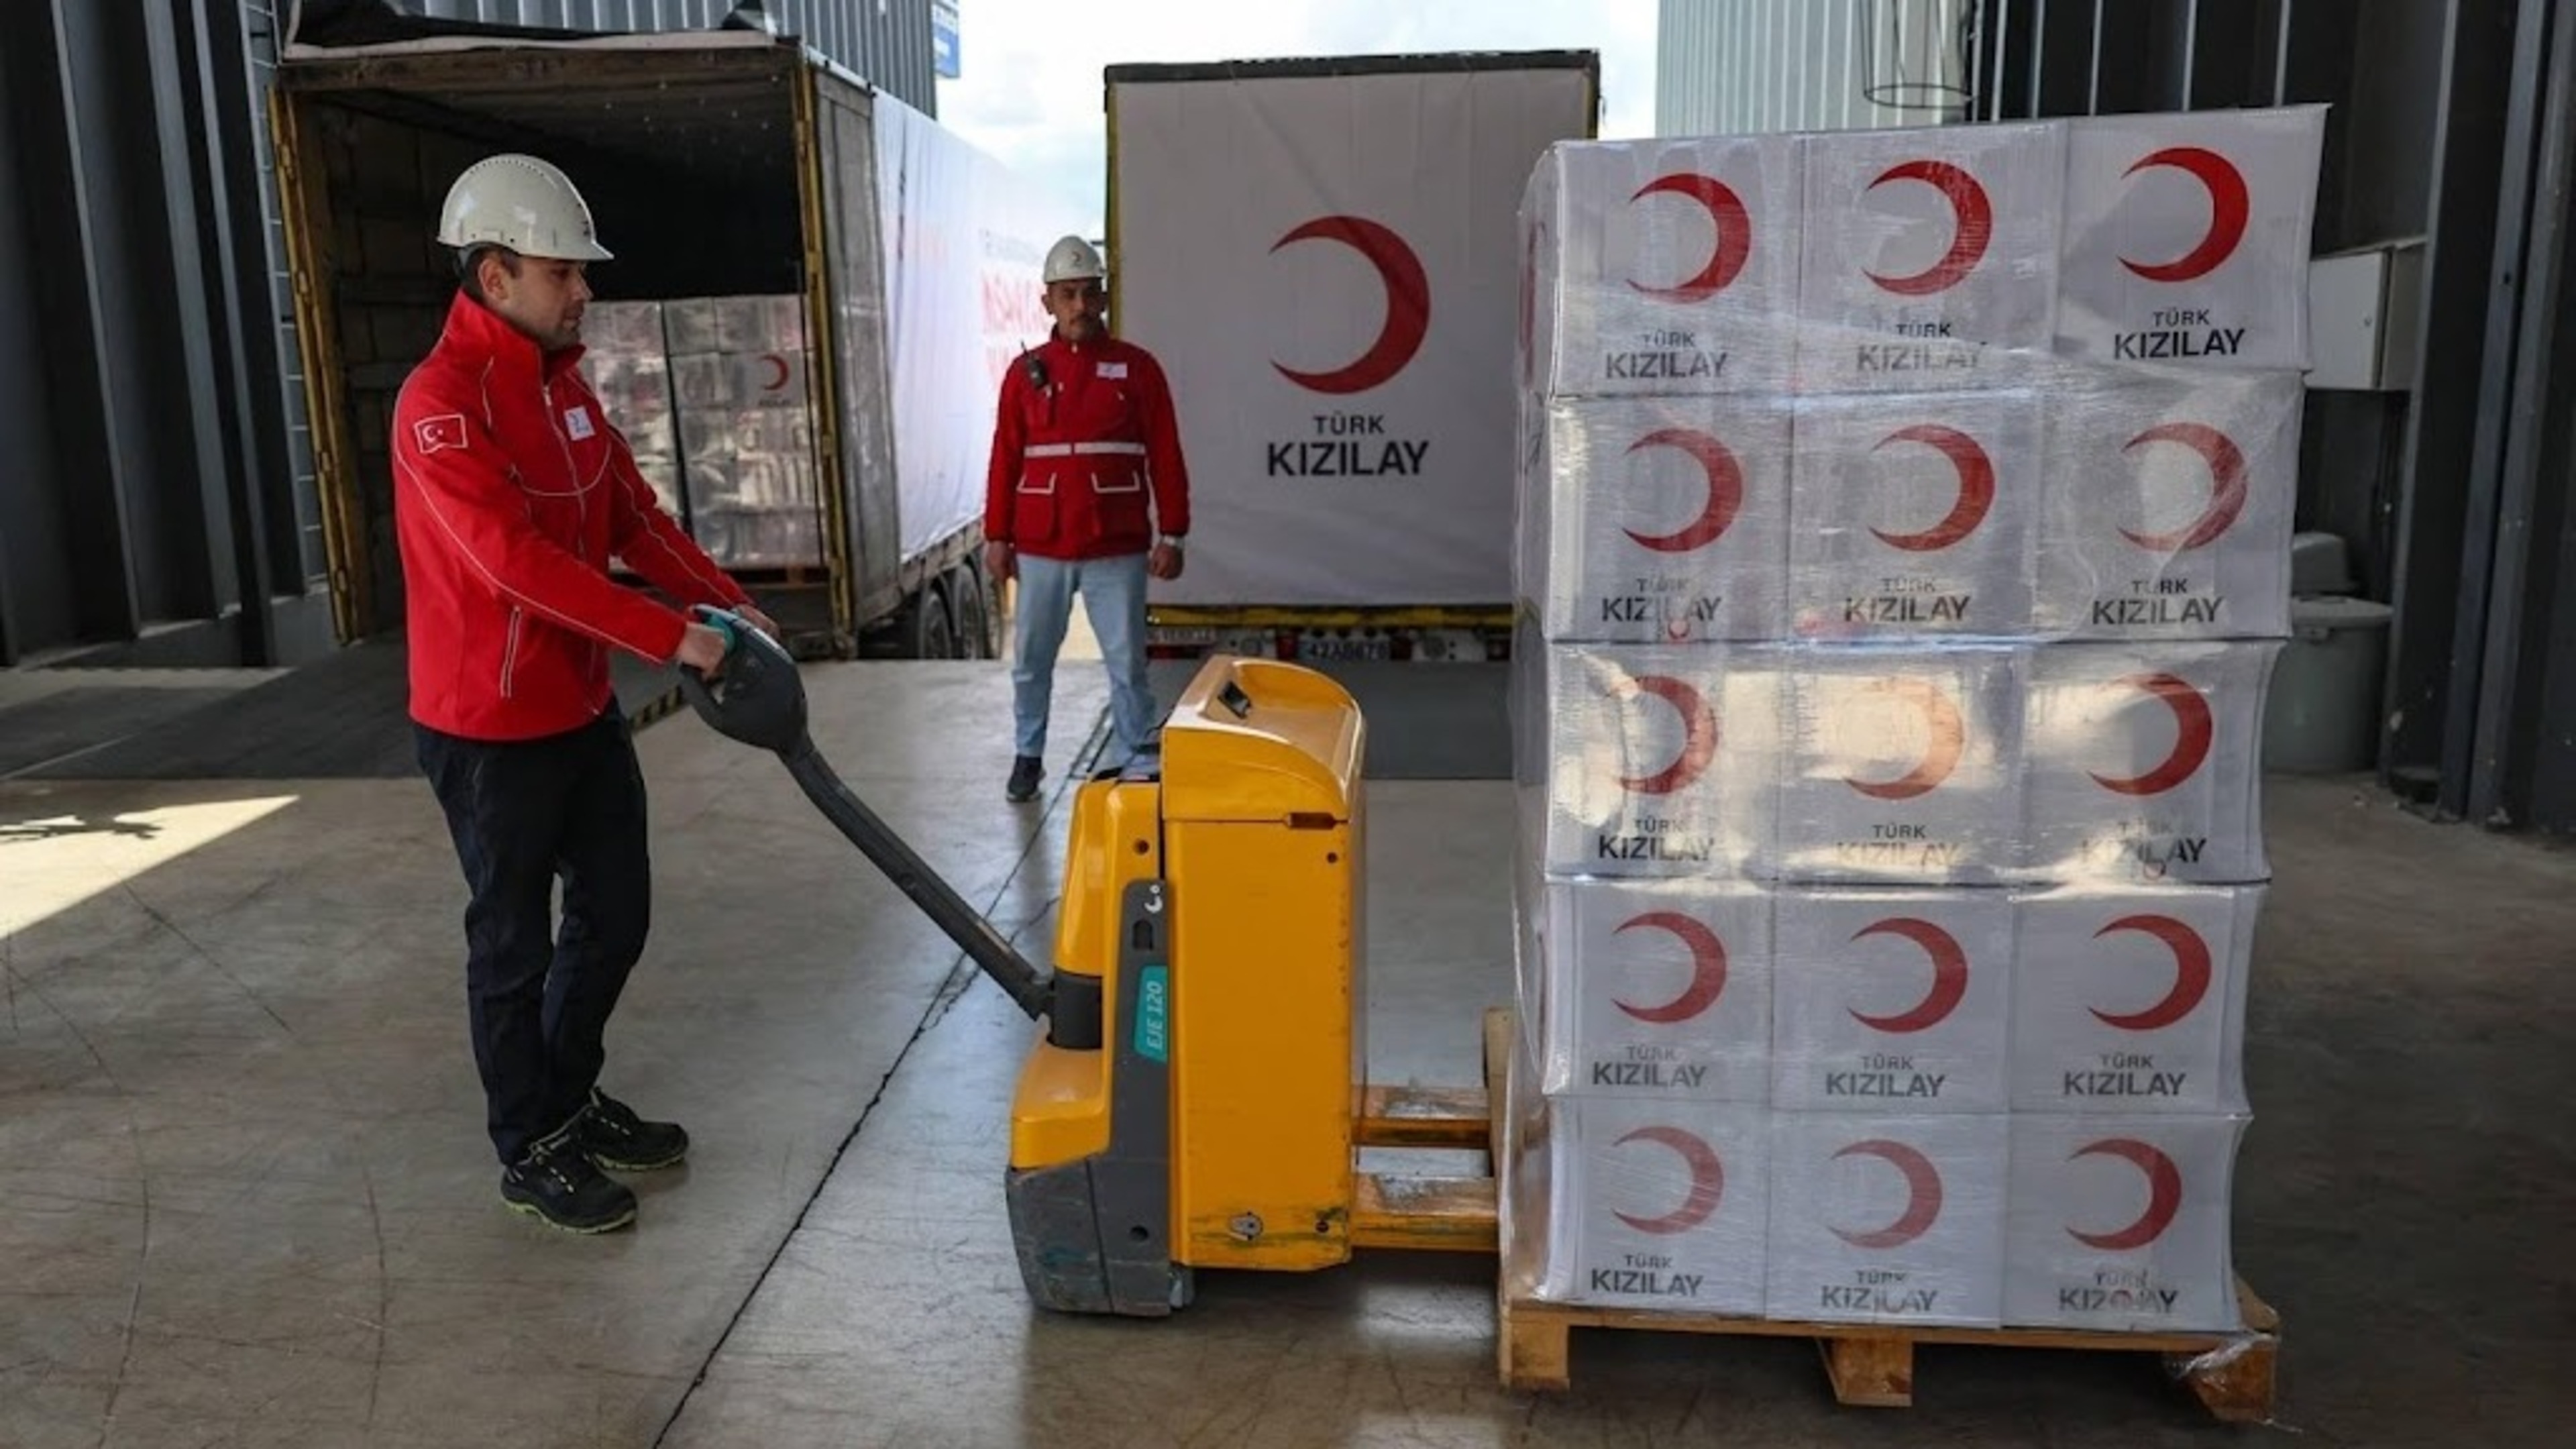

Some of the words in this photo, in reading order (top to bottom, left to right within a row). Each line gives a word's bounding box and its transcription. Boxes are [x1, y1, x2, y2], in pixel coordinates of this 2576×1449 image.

[2153, 307, 2210, 327] TÜRK
[1643, 329, 1696, 347] TÜRK
[2114, 329, 2245, 360] KIZILAY
[1606, 352, 1728, 378] KIZILAY
[1313, 411, 1385, 435] TÜRK
[1268, 441, 1430, 476] KIZILAY
[2131, 578, 2188, 594] TRK
[1845, 596, 1970, 623] KIZILAY
[2092, 596, 2224, 625] KIZILAY
[1874, 822, 1926, 839] TÜRK
[1146, 980, 1164, 1016] 120
[1146, 1017, 1164, 1052] EJE
[1627, 1043, 1676, 1060] TÜRK
[1862, 1053, 1914, 1070] TÜRK
[2099, 1052, 2154, 1069] TÜRK
[1593, 1062, 1707, 1087] KIZILAY
[1826, 1073, 1946, 1097] KIZILAY
[2063, 1072, 2186, 1095] KIZILAY
[1625, 1253, 1672, 1269] TÜRK
[1591, 1269, 1703, 1297] KIZILAY
